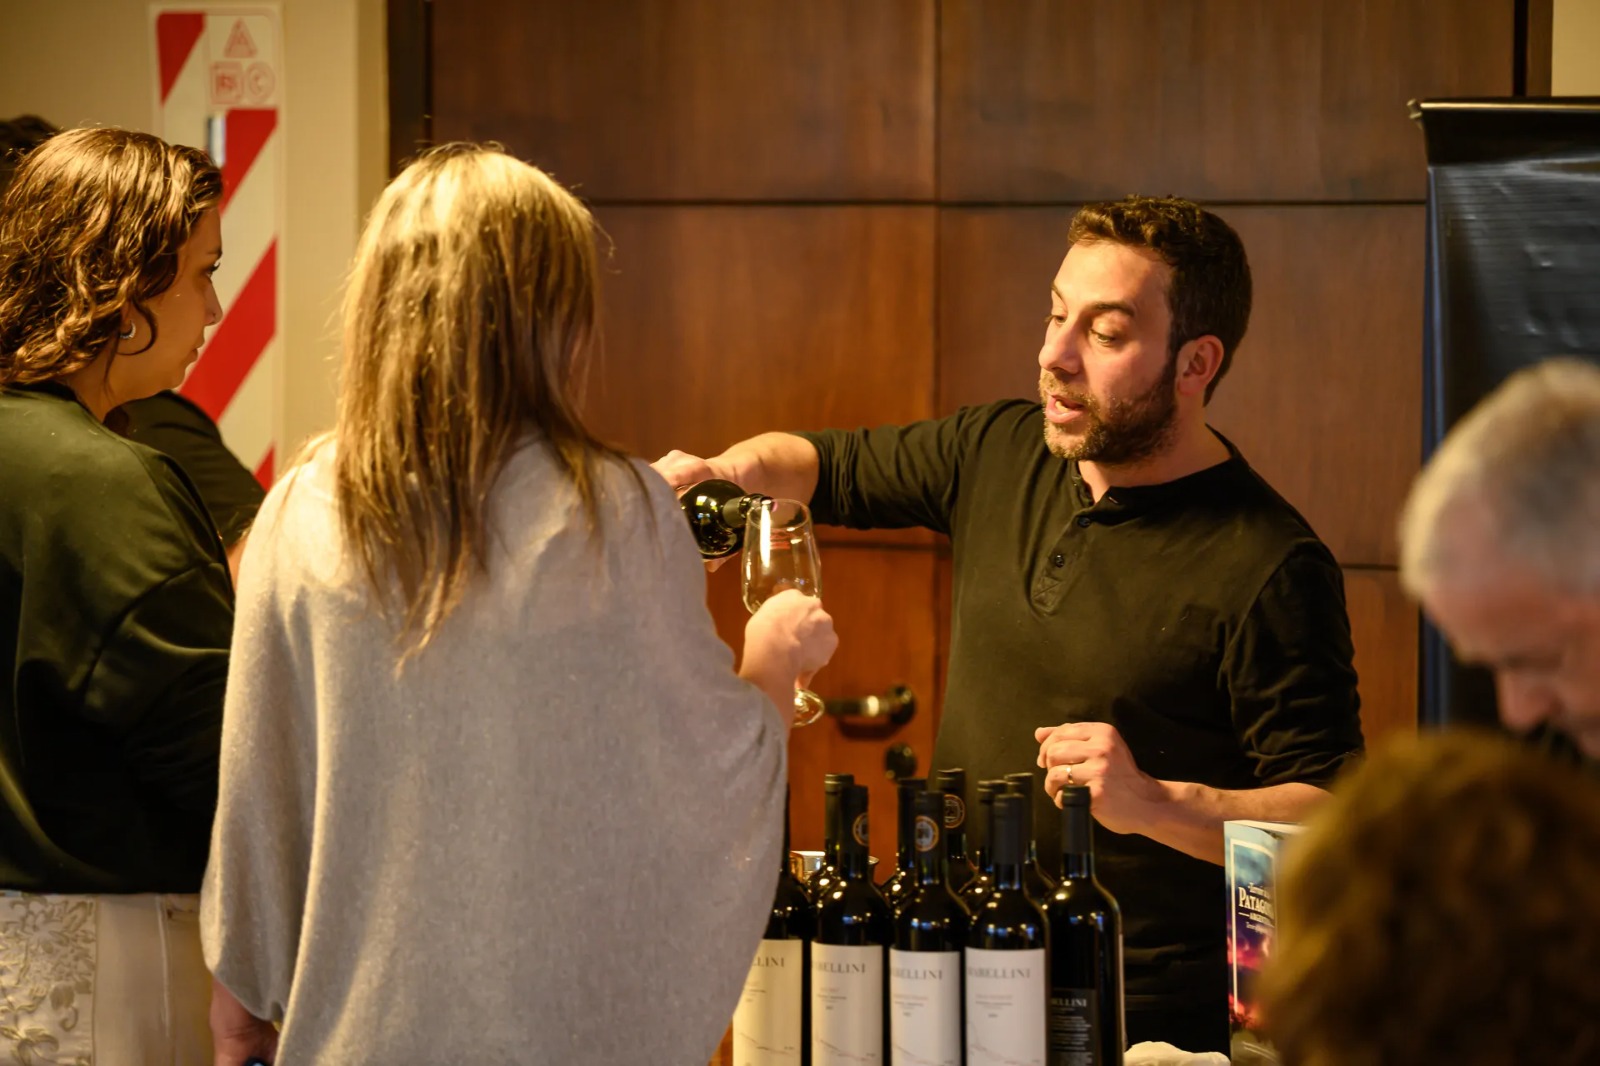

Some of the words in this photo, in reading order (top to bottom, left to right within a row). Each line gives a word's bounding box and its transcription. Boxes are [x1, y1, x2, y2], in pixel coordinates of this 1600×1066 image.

[1238, 886, 1275, 920] PATAG
[752, 957, 785, 968] LINI
[815, 961, 866, 973] BELLINI
